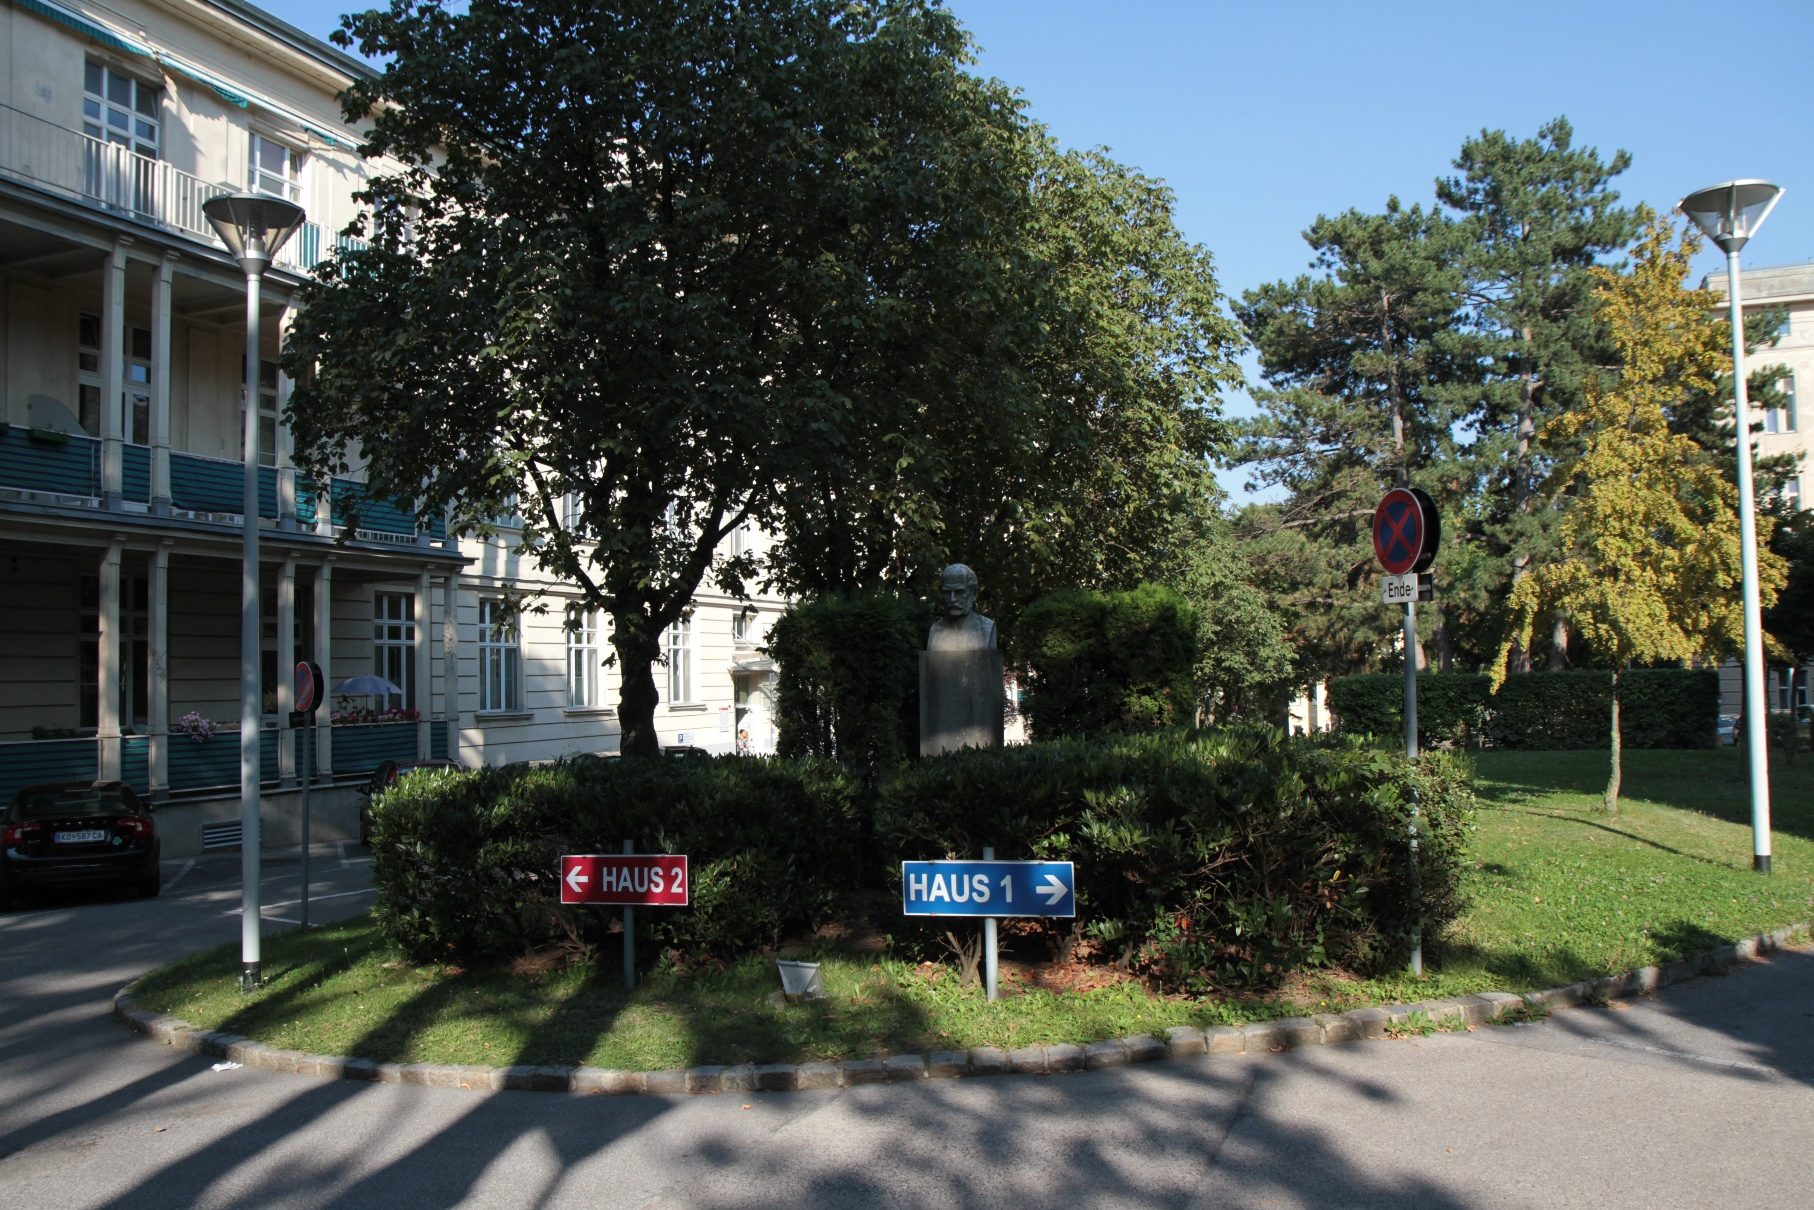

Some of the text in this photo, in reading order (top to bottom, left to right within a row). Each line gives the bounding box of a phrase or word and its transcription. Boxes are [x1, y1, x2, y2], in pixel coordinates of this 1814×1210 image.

[1388, 582, 1411, 598] Ende
[602, 866, 683, 893] HAUS 2
[909, 873, 1013, 903] HAUS 1
